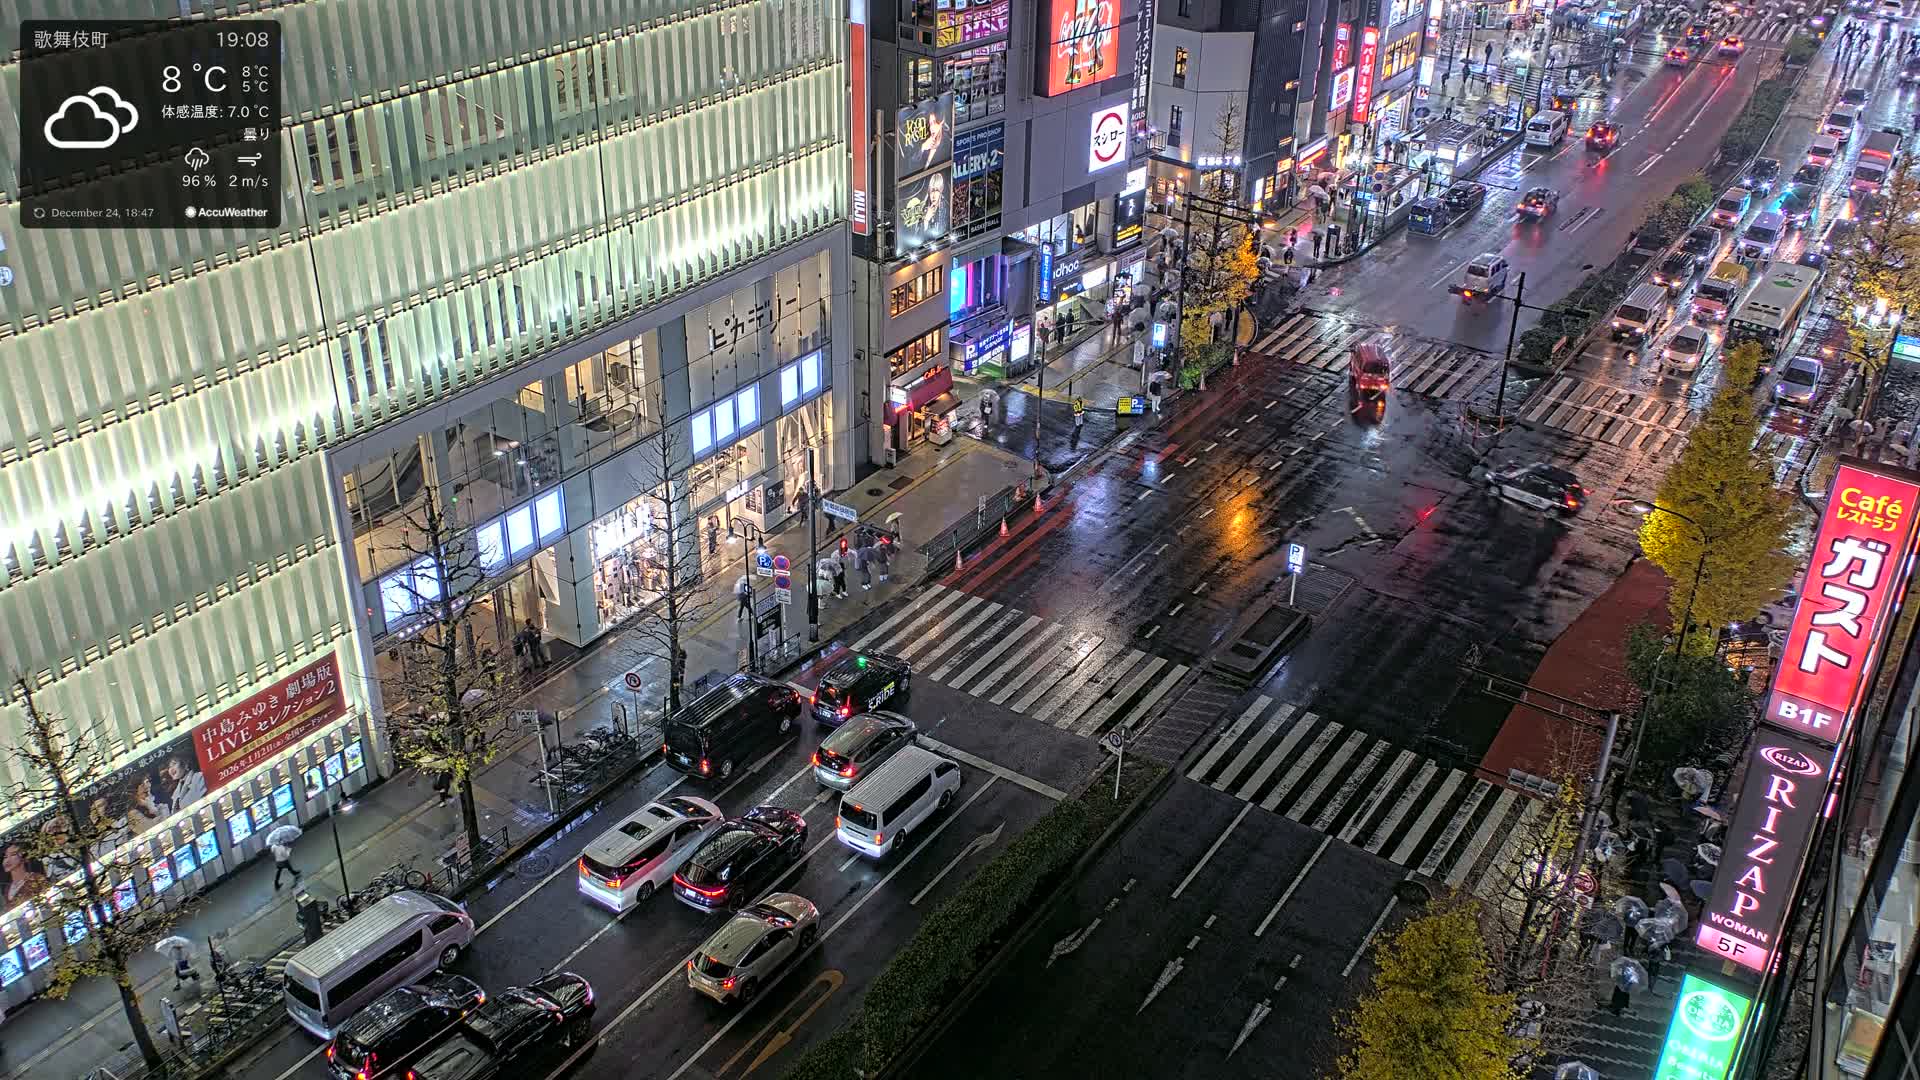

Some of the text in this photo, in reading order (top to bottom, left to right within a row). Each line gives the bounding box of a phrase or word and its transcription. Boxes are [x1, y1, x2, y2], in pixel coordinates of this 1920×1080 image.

[1357, 47, 1375, 113] バーガーキング
[1094, 129, 1125, 147] スシロー
[853, 190, 866, 224] MUJI
[712, 297, 797, 354] ピカデリー
[1837, 507, 1898, 532] レストラン
[1841, 487, 1903, 519] Café
[1799, 535, 1890, 674] ガスト
[201, 694, 279, 744] 中島みゆき
[286, 662, 333, 700] 劇場版
[1777, 701, 1833, 730] B1F
[207, 726, 253, 762] LIVE
[1775, 752, 1808, 769] RIZAP
[1728, 773, 1796, 918] RIZAP
[1710, 911, 1769, 943] WOMAN
[1717, 937, 1747, 956] 5F
